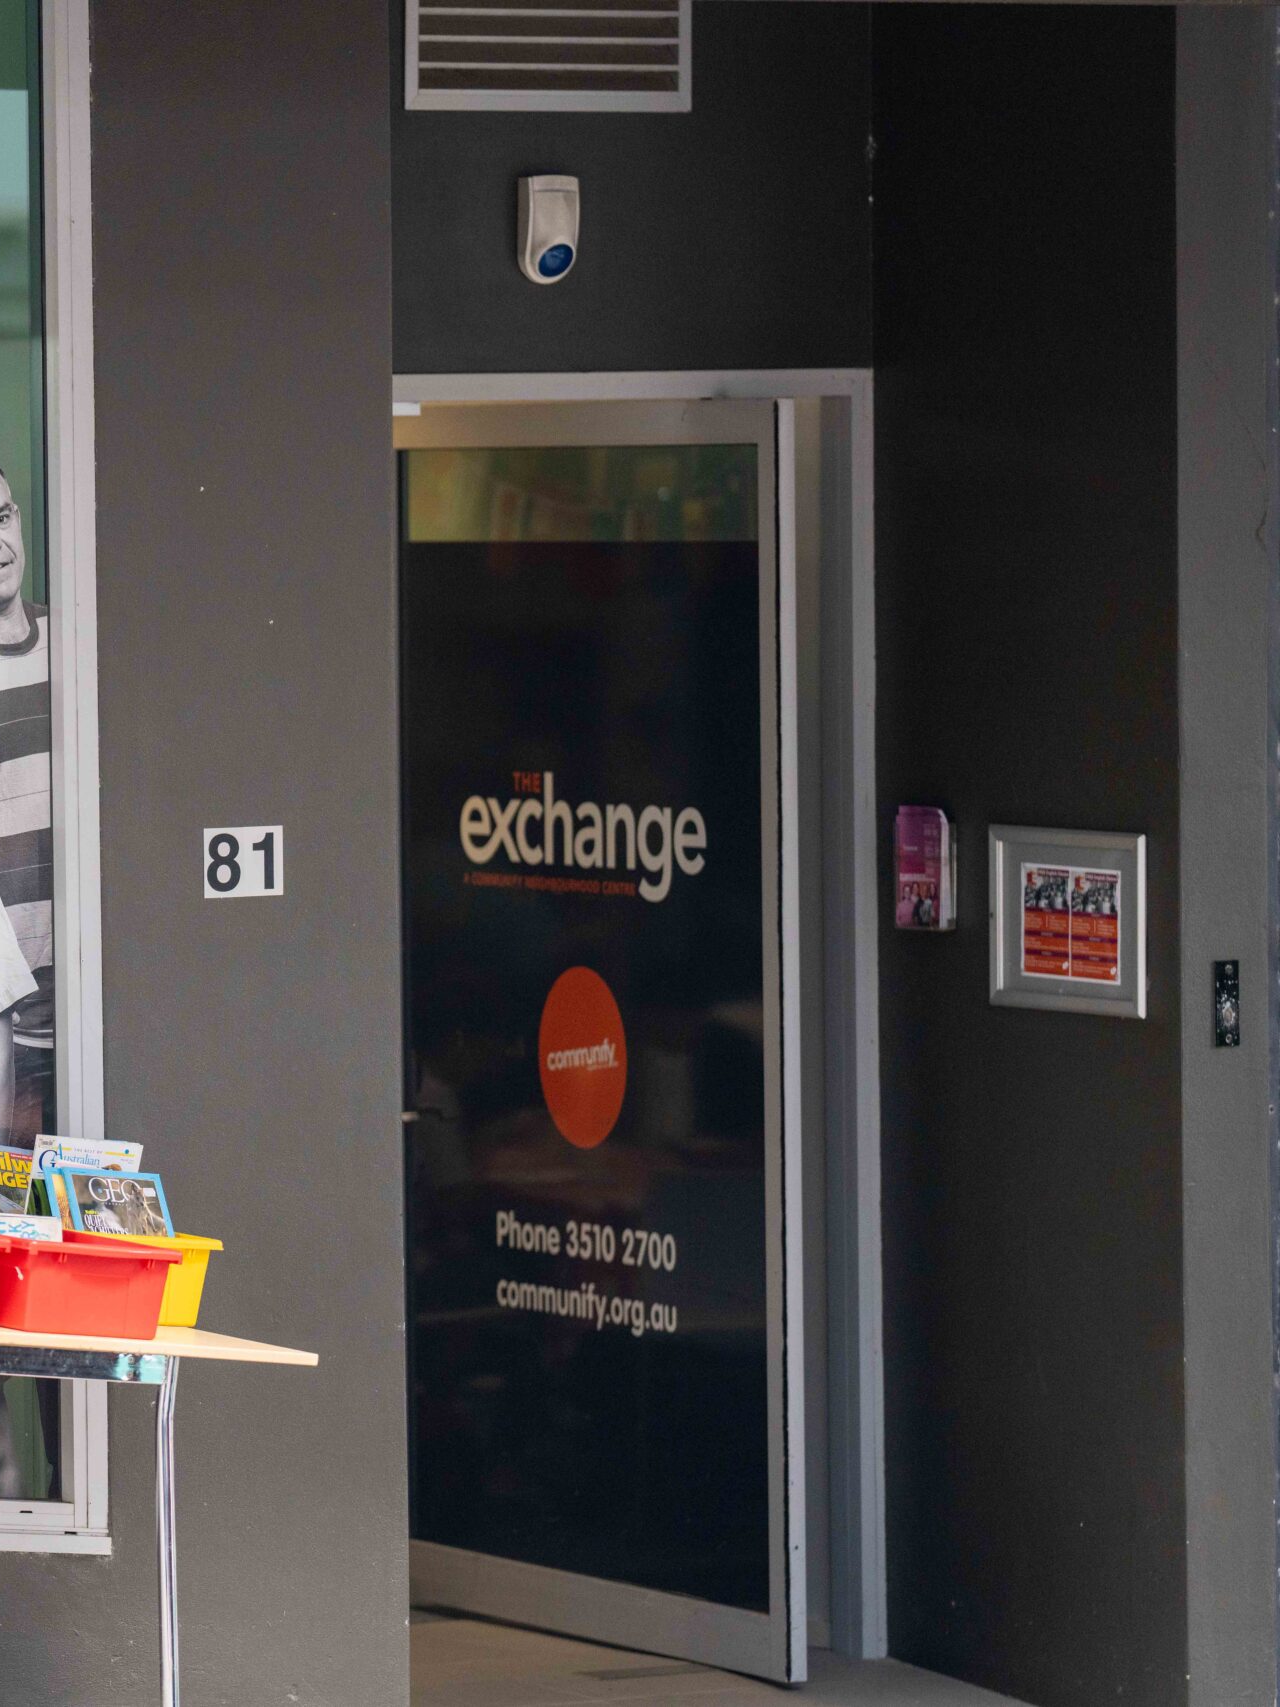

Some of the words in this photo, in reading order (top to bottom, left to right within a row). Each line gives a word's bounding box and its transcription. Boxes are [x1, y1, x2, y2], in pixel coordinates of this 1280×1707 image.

[513, 771, 540, 793] THE
[206, 832, 275, 892] 81
[460, 771, 708, 903] exchange
[496, 1209, 561, 1256] Phone
[565, 1219, 616, 1264] 3510
[621, 1228, 676, 1272] 2700
[496, 1278, 678, 1338] communify.org.au
